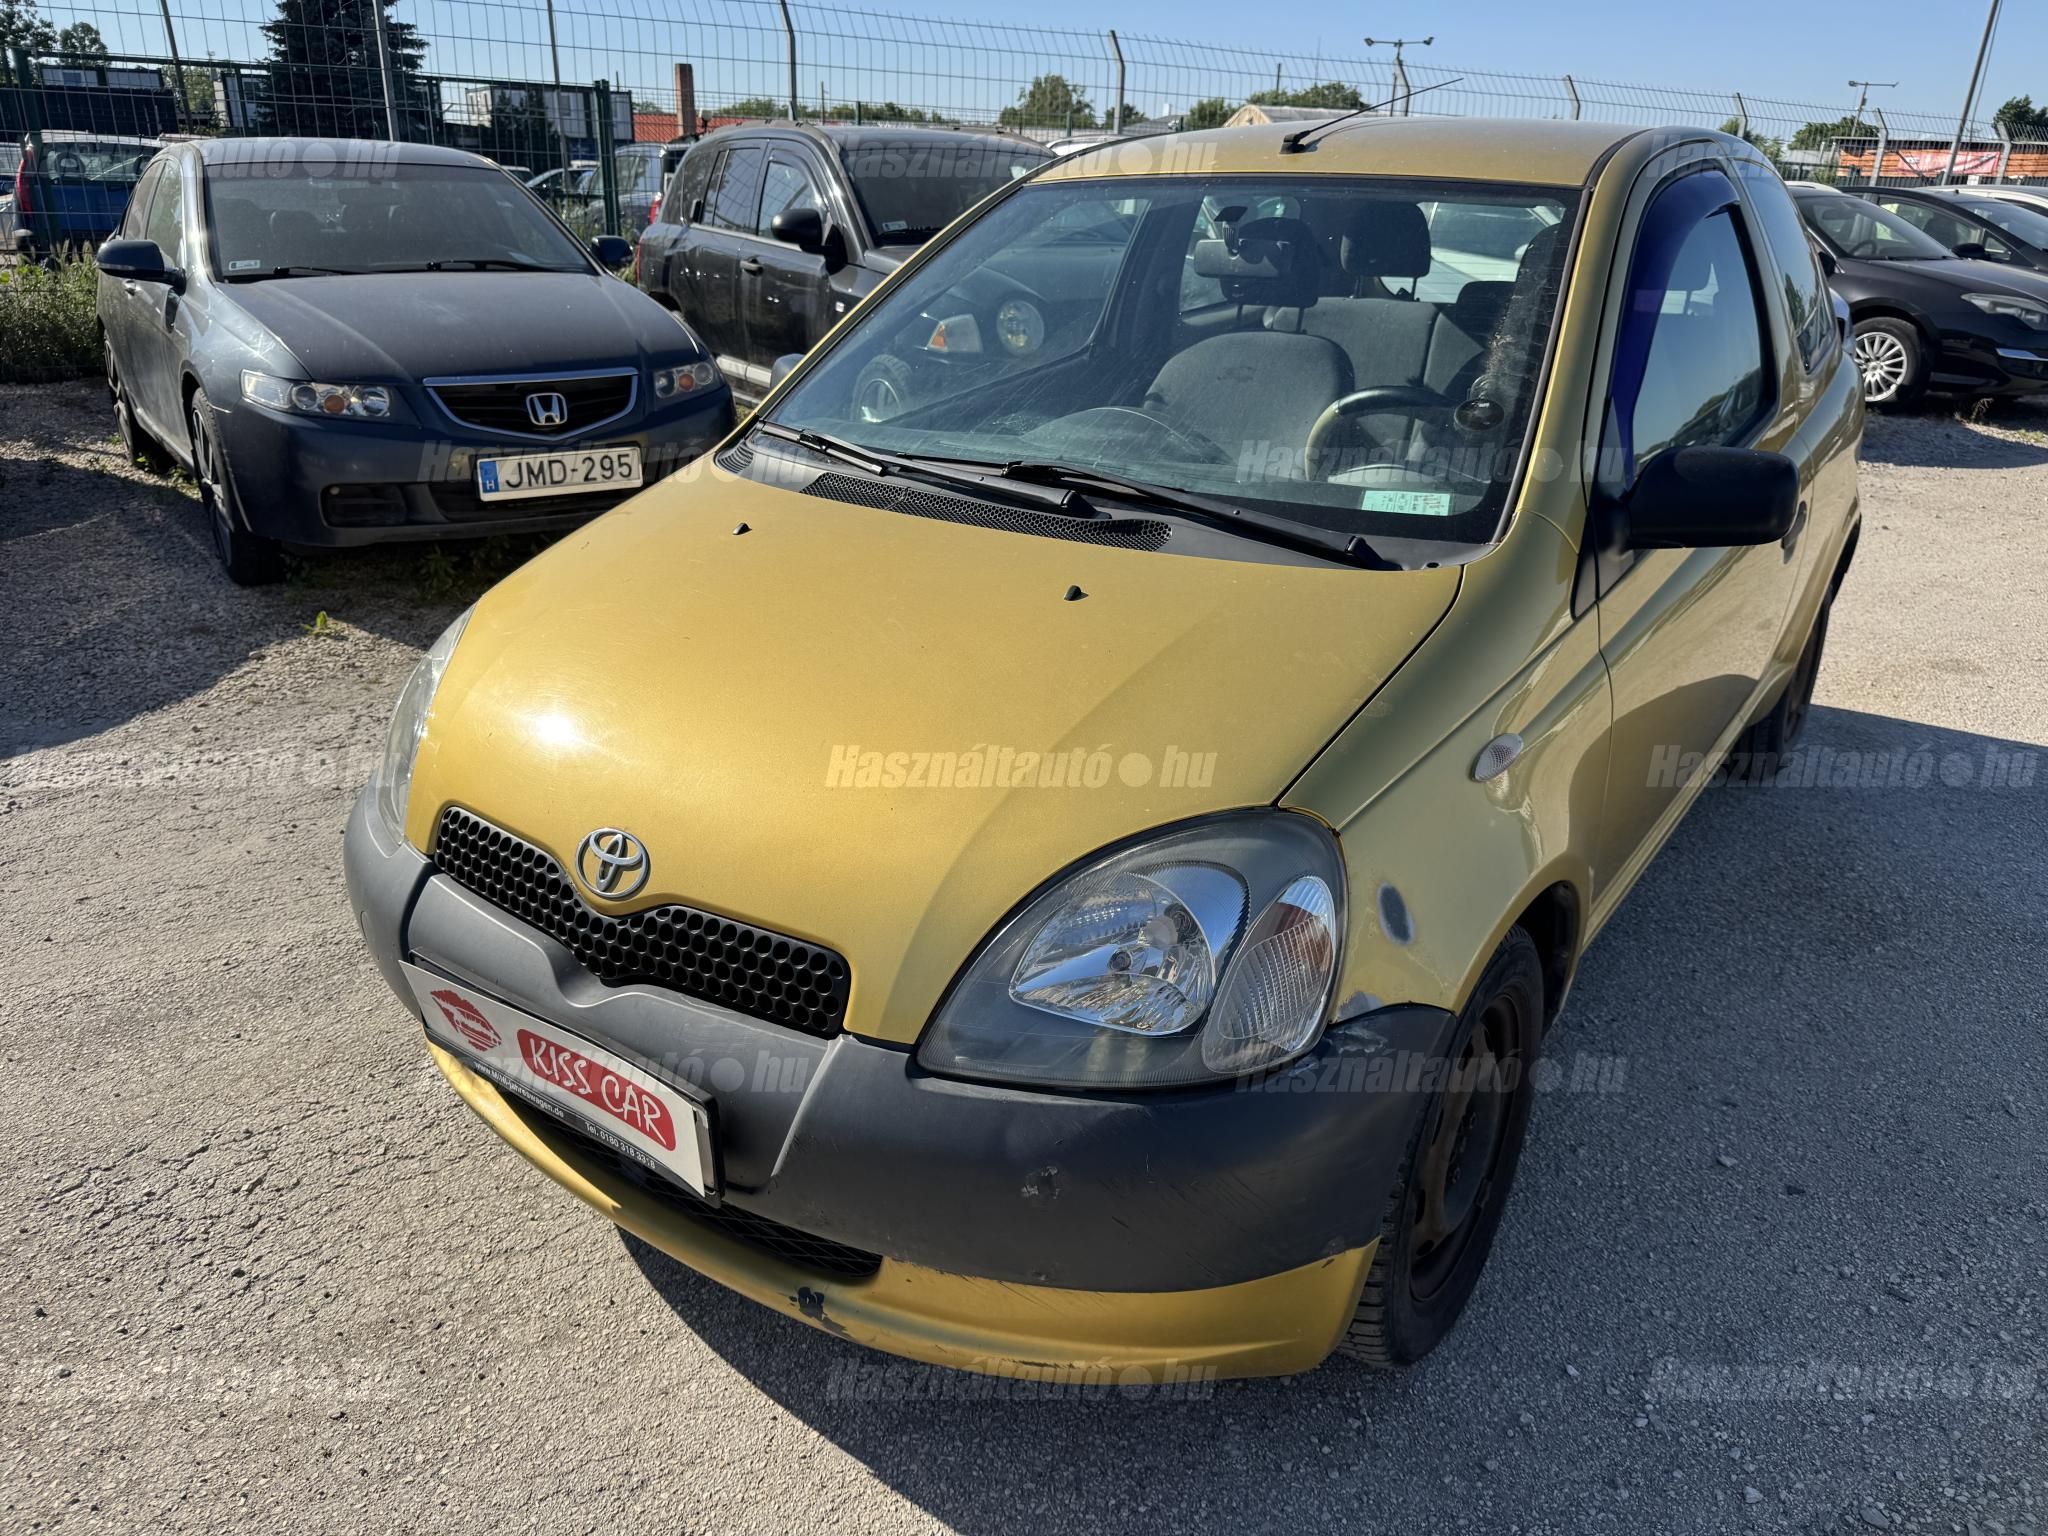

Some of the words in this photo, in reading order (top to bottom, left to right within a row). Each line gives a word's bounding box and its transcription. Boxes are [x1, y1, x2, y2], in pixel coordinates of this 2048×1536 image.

[506, 454, 632, 488] JMD-295
[529, 1038, 592, 1095] KISS
[601, 1074, 666, 1146] CAR
